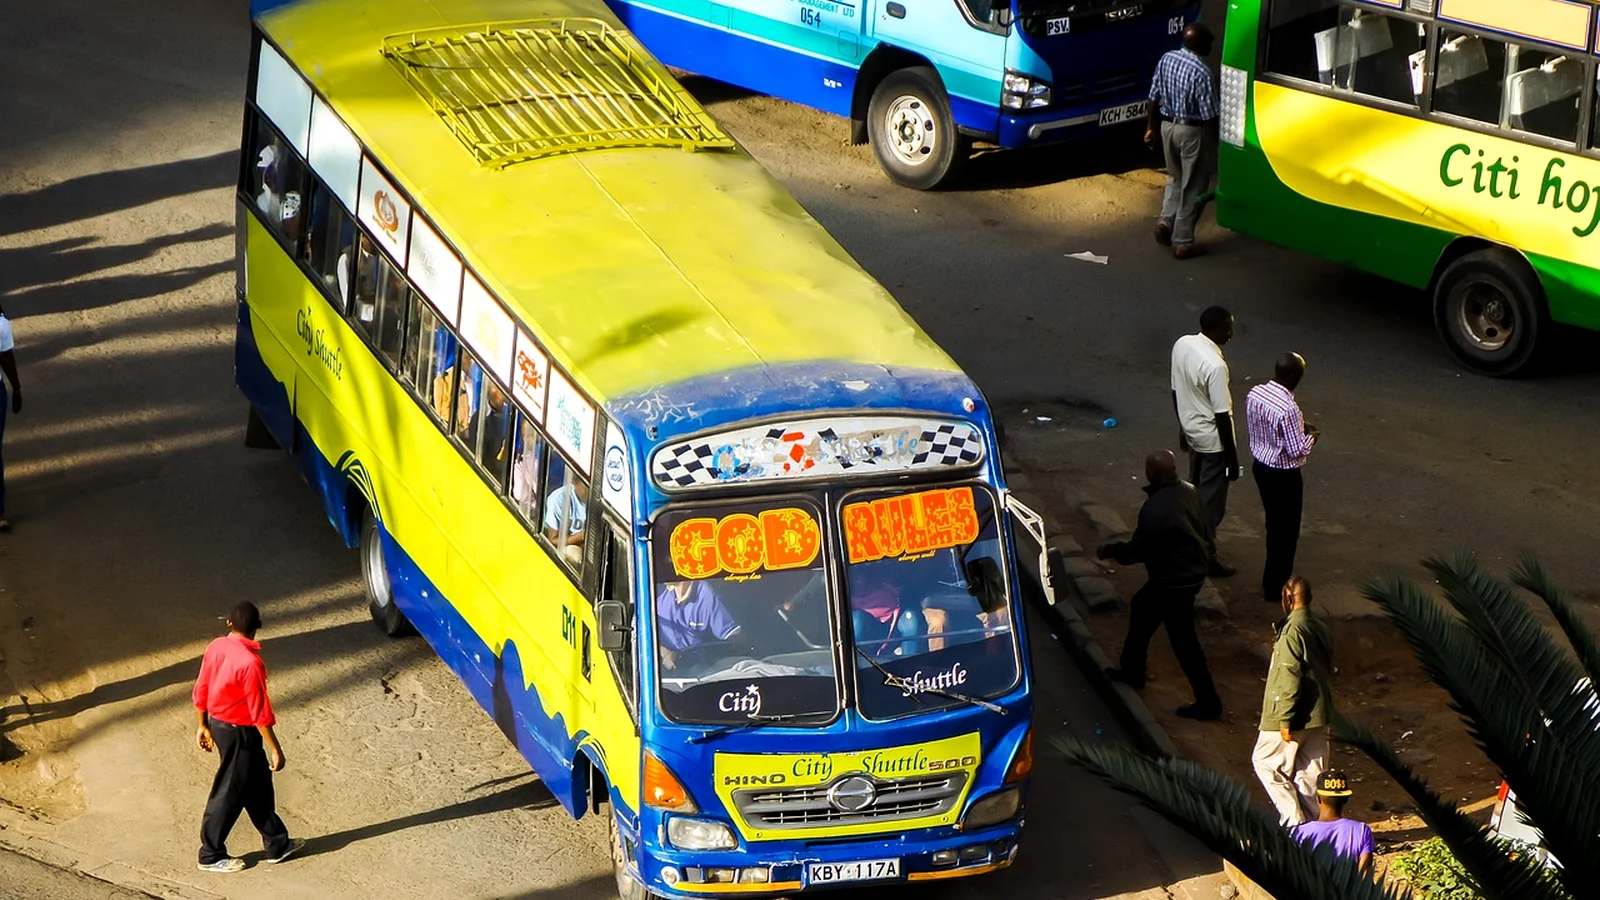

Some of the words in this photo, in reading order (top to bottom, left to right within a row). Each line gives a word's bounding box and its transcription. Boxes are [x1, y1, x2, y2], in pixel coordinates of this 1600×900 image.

[800, 7, 821, 28] 054
[842, 7, 855, 18] LTD
[1105, 4, 1143, 20] ISUZU
[1167, 15, 1185, 35] 054
[1101, 108, 1121, 124] KCH
[1440, 143, 1520, 199] Citi
[669, 507, 821, 579] GOD
[843, 486, 979, 564] RULES
[718, 684, 762, 718] City
[901, 662, 967, 698] Shuttle
[791, 754, 833, 781] City
[861, 748, 928, 774] Shuttle
[928, 756, 977, 772] 500
[724, 773, 786, 786] HINO
[812, 865, 843, 881] KBY
[856, 861, 896, 879] 117A
